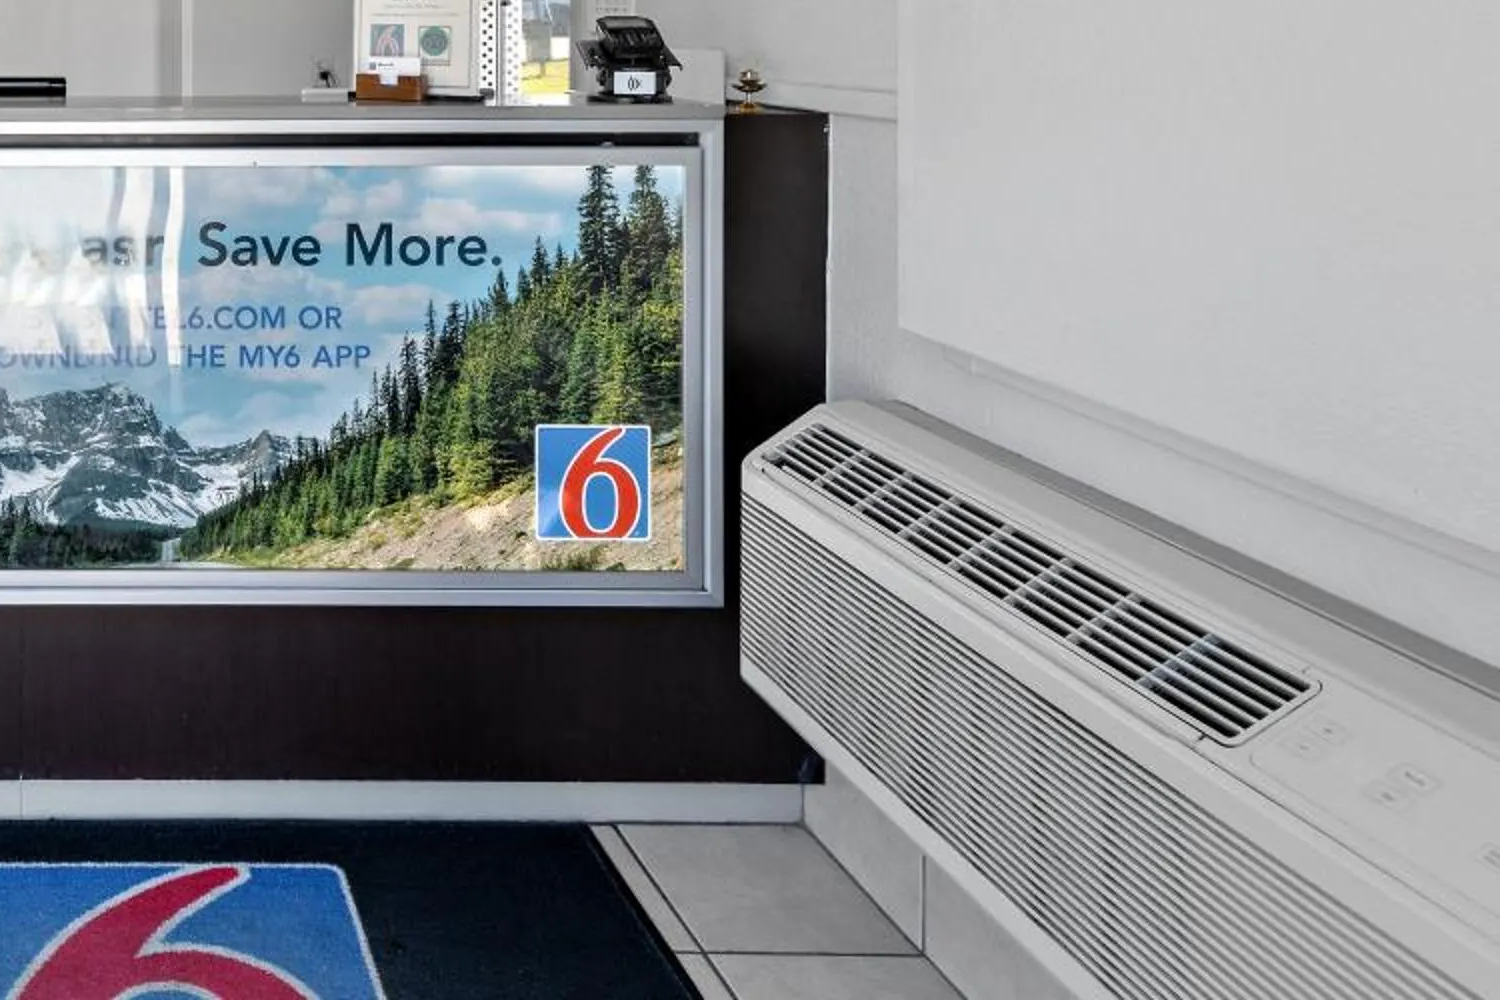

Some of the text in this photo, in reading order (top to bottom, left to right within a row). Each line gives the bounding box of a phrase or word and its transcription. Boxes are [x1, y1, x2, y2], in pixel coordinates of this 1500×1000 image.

[197, 221, 322, 267] Save
[345, 221, 502, 267] More.
[298, 305, 343, 330] OR
[239, 345, 301, 369] MY6
[312, 345, 372, 369] APP
[559, 426, 642, 540] 6
